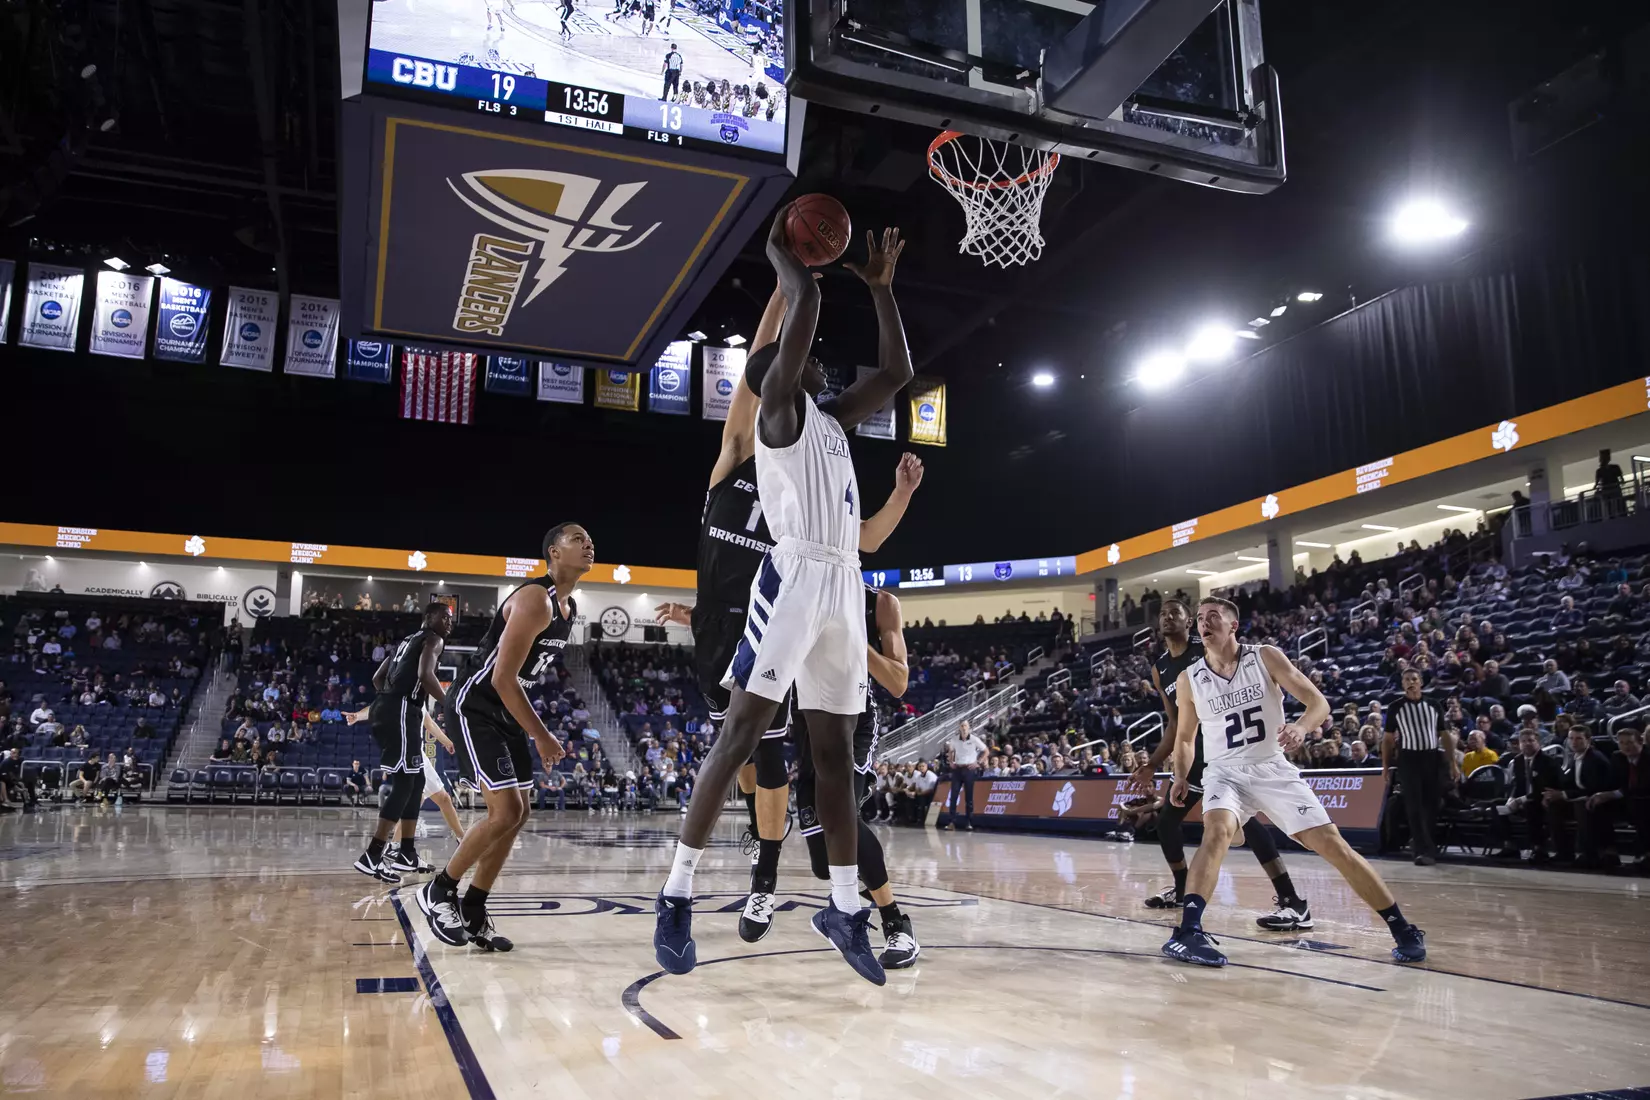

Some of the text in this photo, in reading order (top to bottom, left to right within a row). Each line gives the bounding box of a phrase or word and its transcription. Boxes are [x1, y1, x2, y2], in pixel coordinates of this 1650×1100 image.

[392, 57, 458, 91] CBU
[492, 74, 516, 100] 19
[564, 87, 608, 114] 13:56
[478, 100, 517, 116] FLS 3
[660, 104, 682, 130] 13
[648, 131, 682, 145] FLS 1
[452, 233, 535, 336] LANCERS
[239, 294, 268, 306] 2015
[301, 302, 328, 313] 2014
[30, 322, 62, 331] DIVISION
[24, 328, 73, 339] TOURNAMENT
[102, 330, 130, 339] DIVISION
[95, 336, 143, 347] TOURNAMENT
[228, 343, 261, 351] DIVISION
[649, 393, 688, 402] CHAMPIONS
[57, 534, 91, 542] MEDICAL
[291, 543, 327, 551] RIVERSIDE
[872, 572, 886, 587] 19
[910, 568, 934, 580] 13:56
[958, 566, 972, 582] 13
[85, 587, 144, 596] ACADEMICALLY
[761, 673, 777, 681] adidas
[1208, 683, 1264, 714] LANCERS
[1225, 705, 1266, 749] 25
[991, 781, 1026, 791] RIVERSIDE
[988, 793, 1016, 802] MEDICAL
[984, 804, 1006, 814] CLINIC
